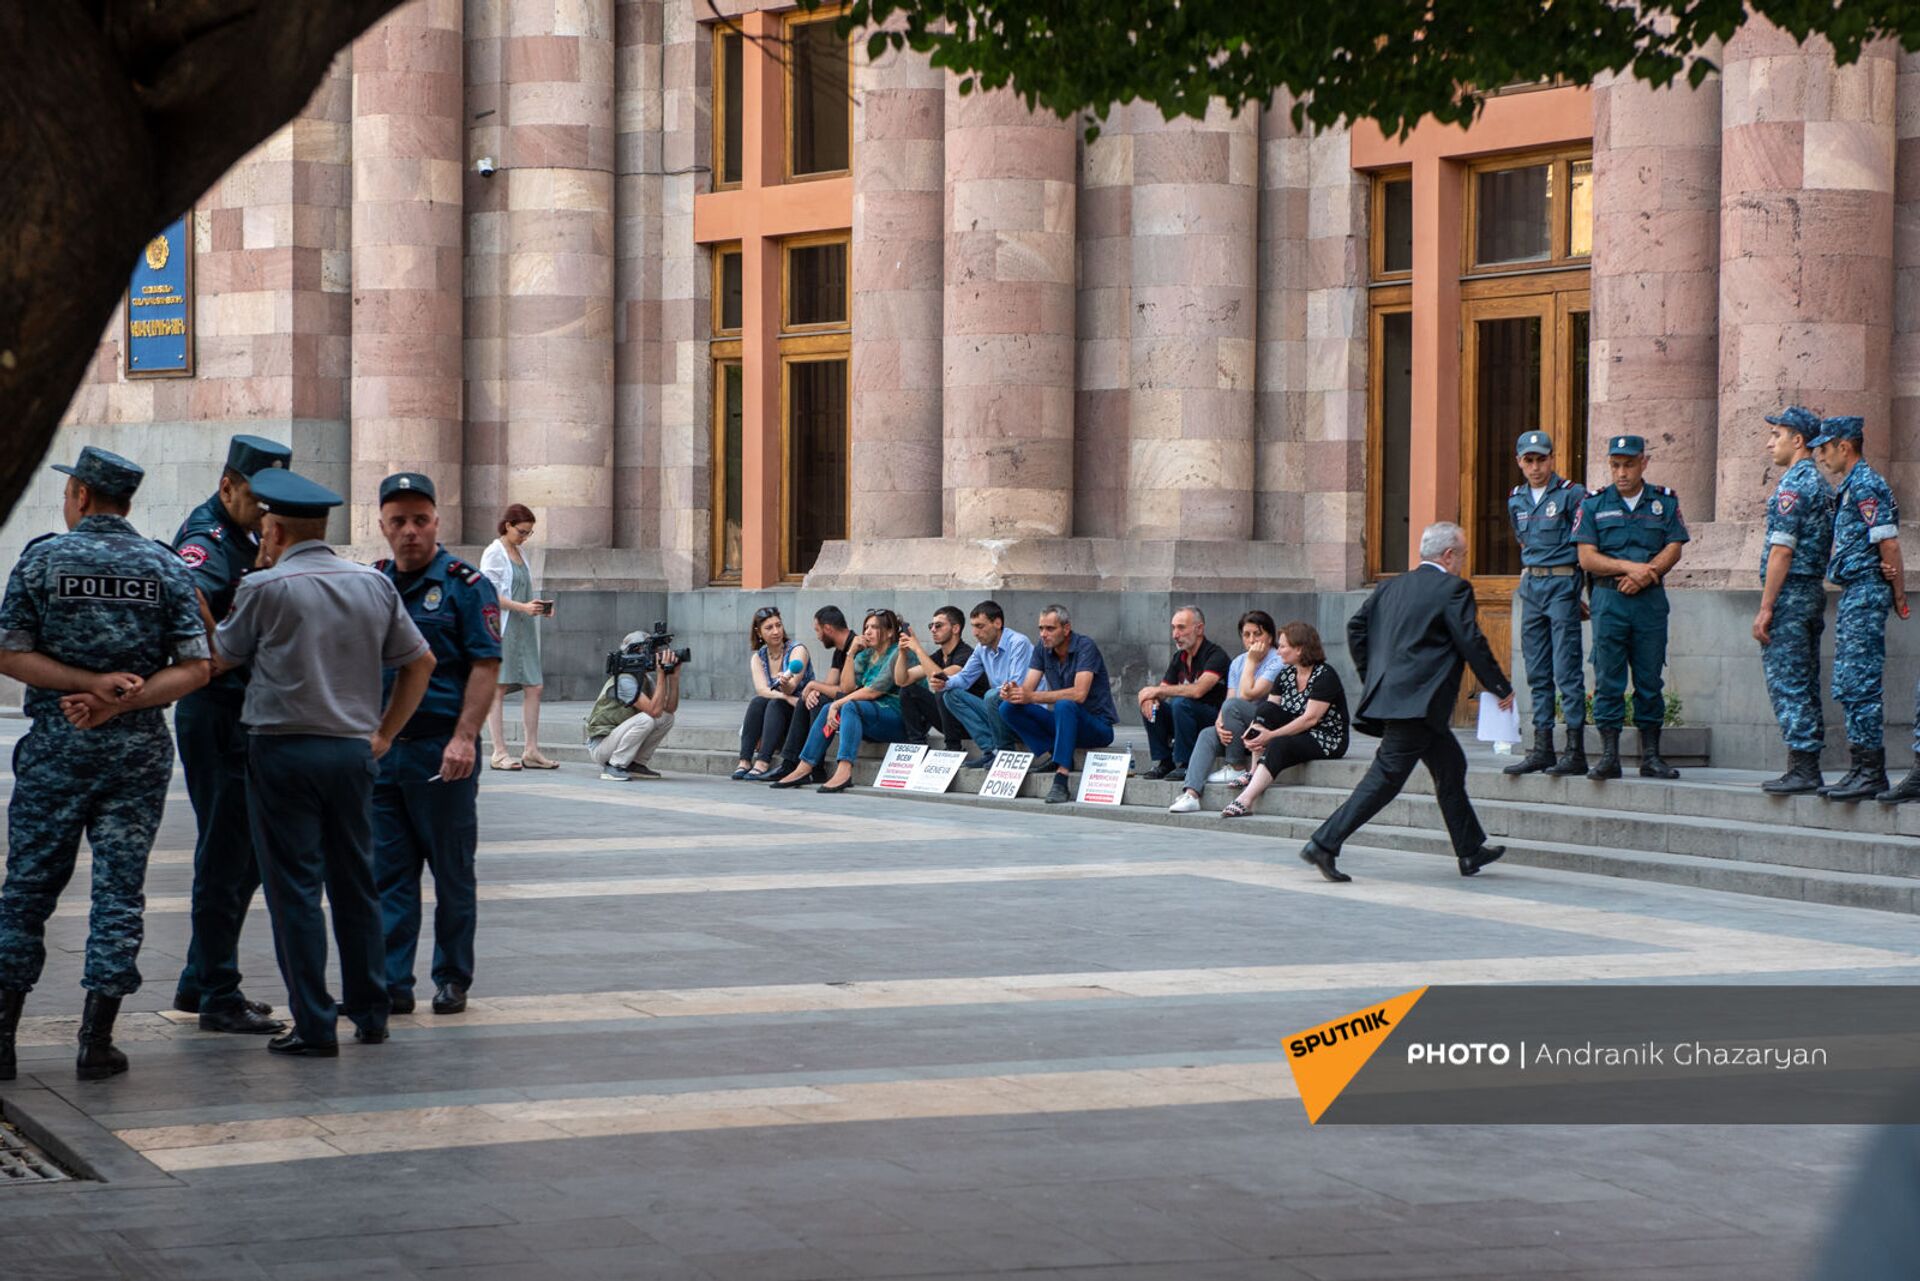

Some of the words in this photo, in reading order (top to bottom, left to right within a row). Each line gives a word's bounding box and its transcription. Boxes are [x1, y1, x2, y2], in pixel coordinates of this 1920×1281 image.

[65, 578, 155, 599] POLICE
[996, 752, 1031, 769] FREE
[924, 765, 951, 774] GENEVA
[991, 770, 1022, 779] ARMENIAN
[984, 780, 1016, 796] POWs
